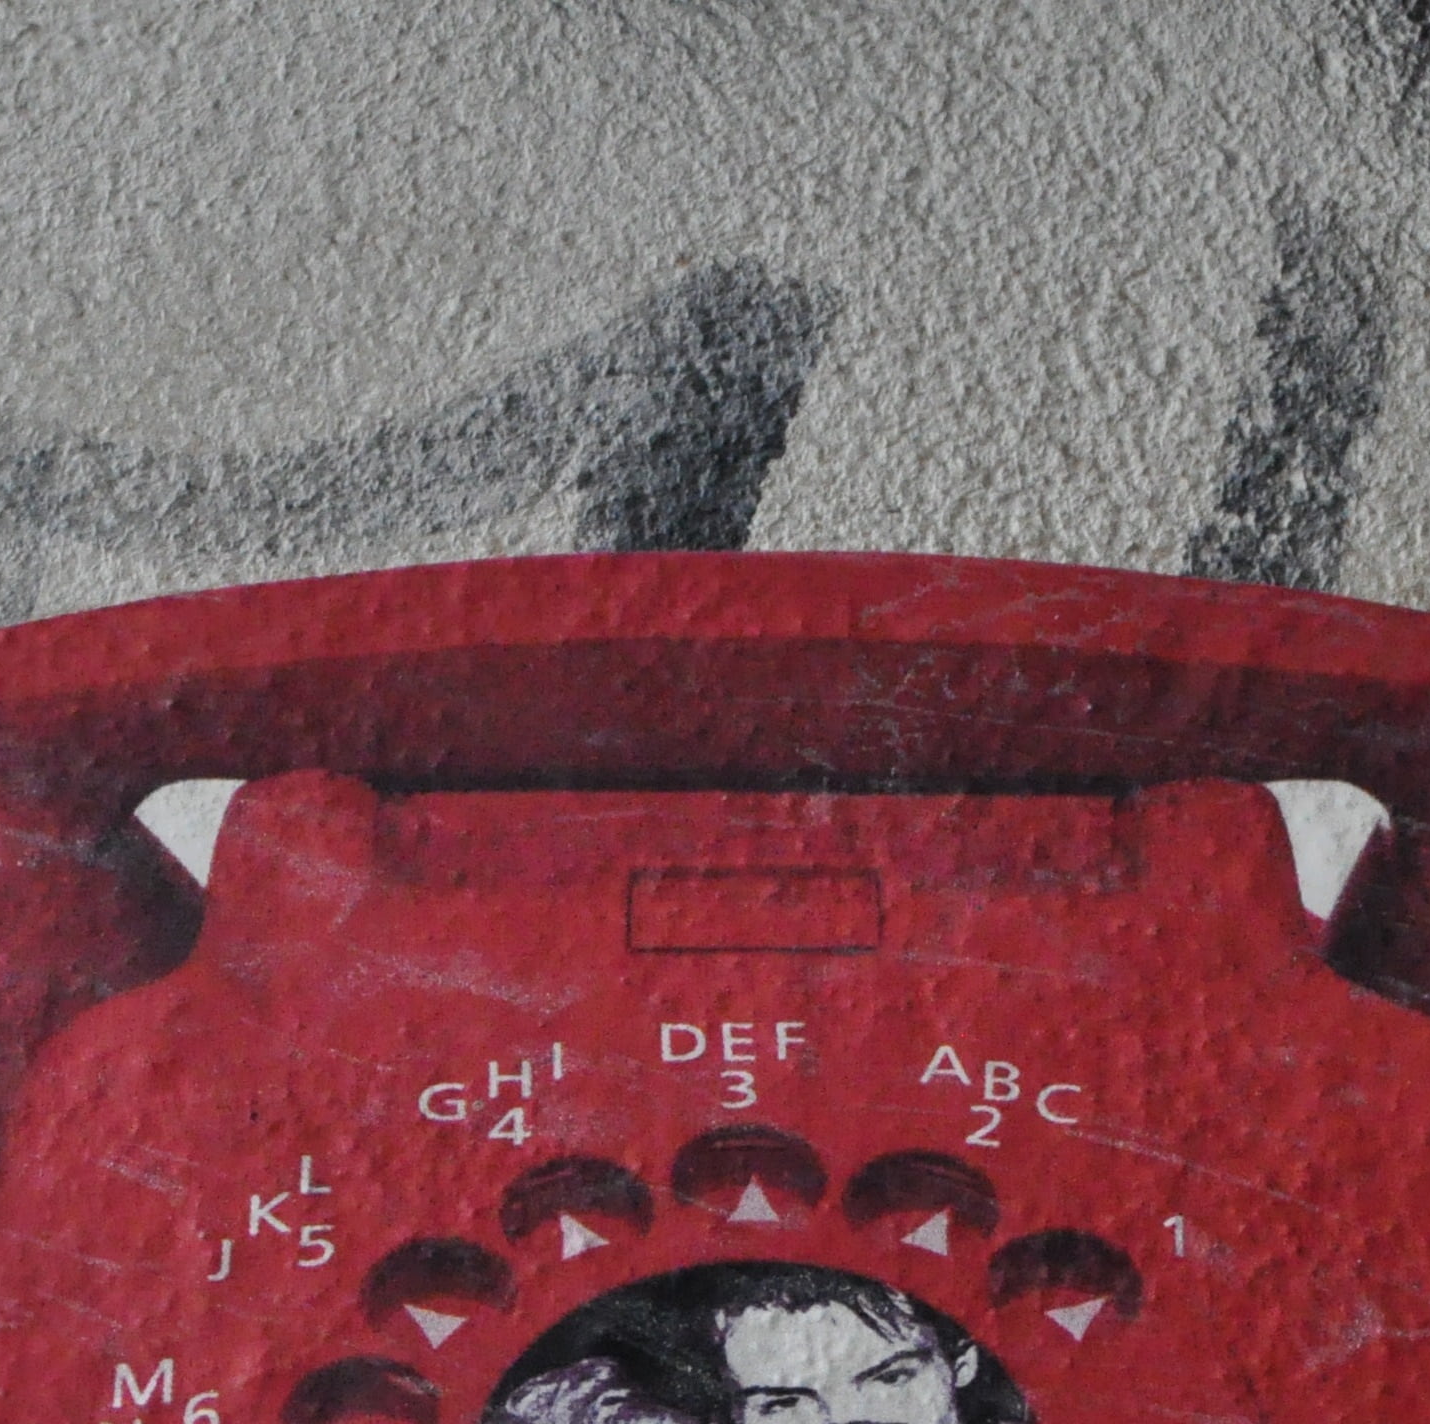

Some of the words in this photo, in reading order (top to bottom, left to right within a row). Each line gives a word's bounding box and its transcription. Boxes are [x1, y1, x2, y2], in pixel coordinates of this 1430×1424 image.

[660, 1021, 807, 1063] DEF
[417, 1041, 567, 1122] GHI
[719, 1069, 759, 1110] 3
[919, 1044, 1082, 1125] ABC
[487, 1106, 533, 1147] 4
[964, 1104, 1002, 1148] 2
[297, 1224, 336, 1268] 5
[1162, 1214, 1185, 1258] 1
